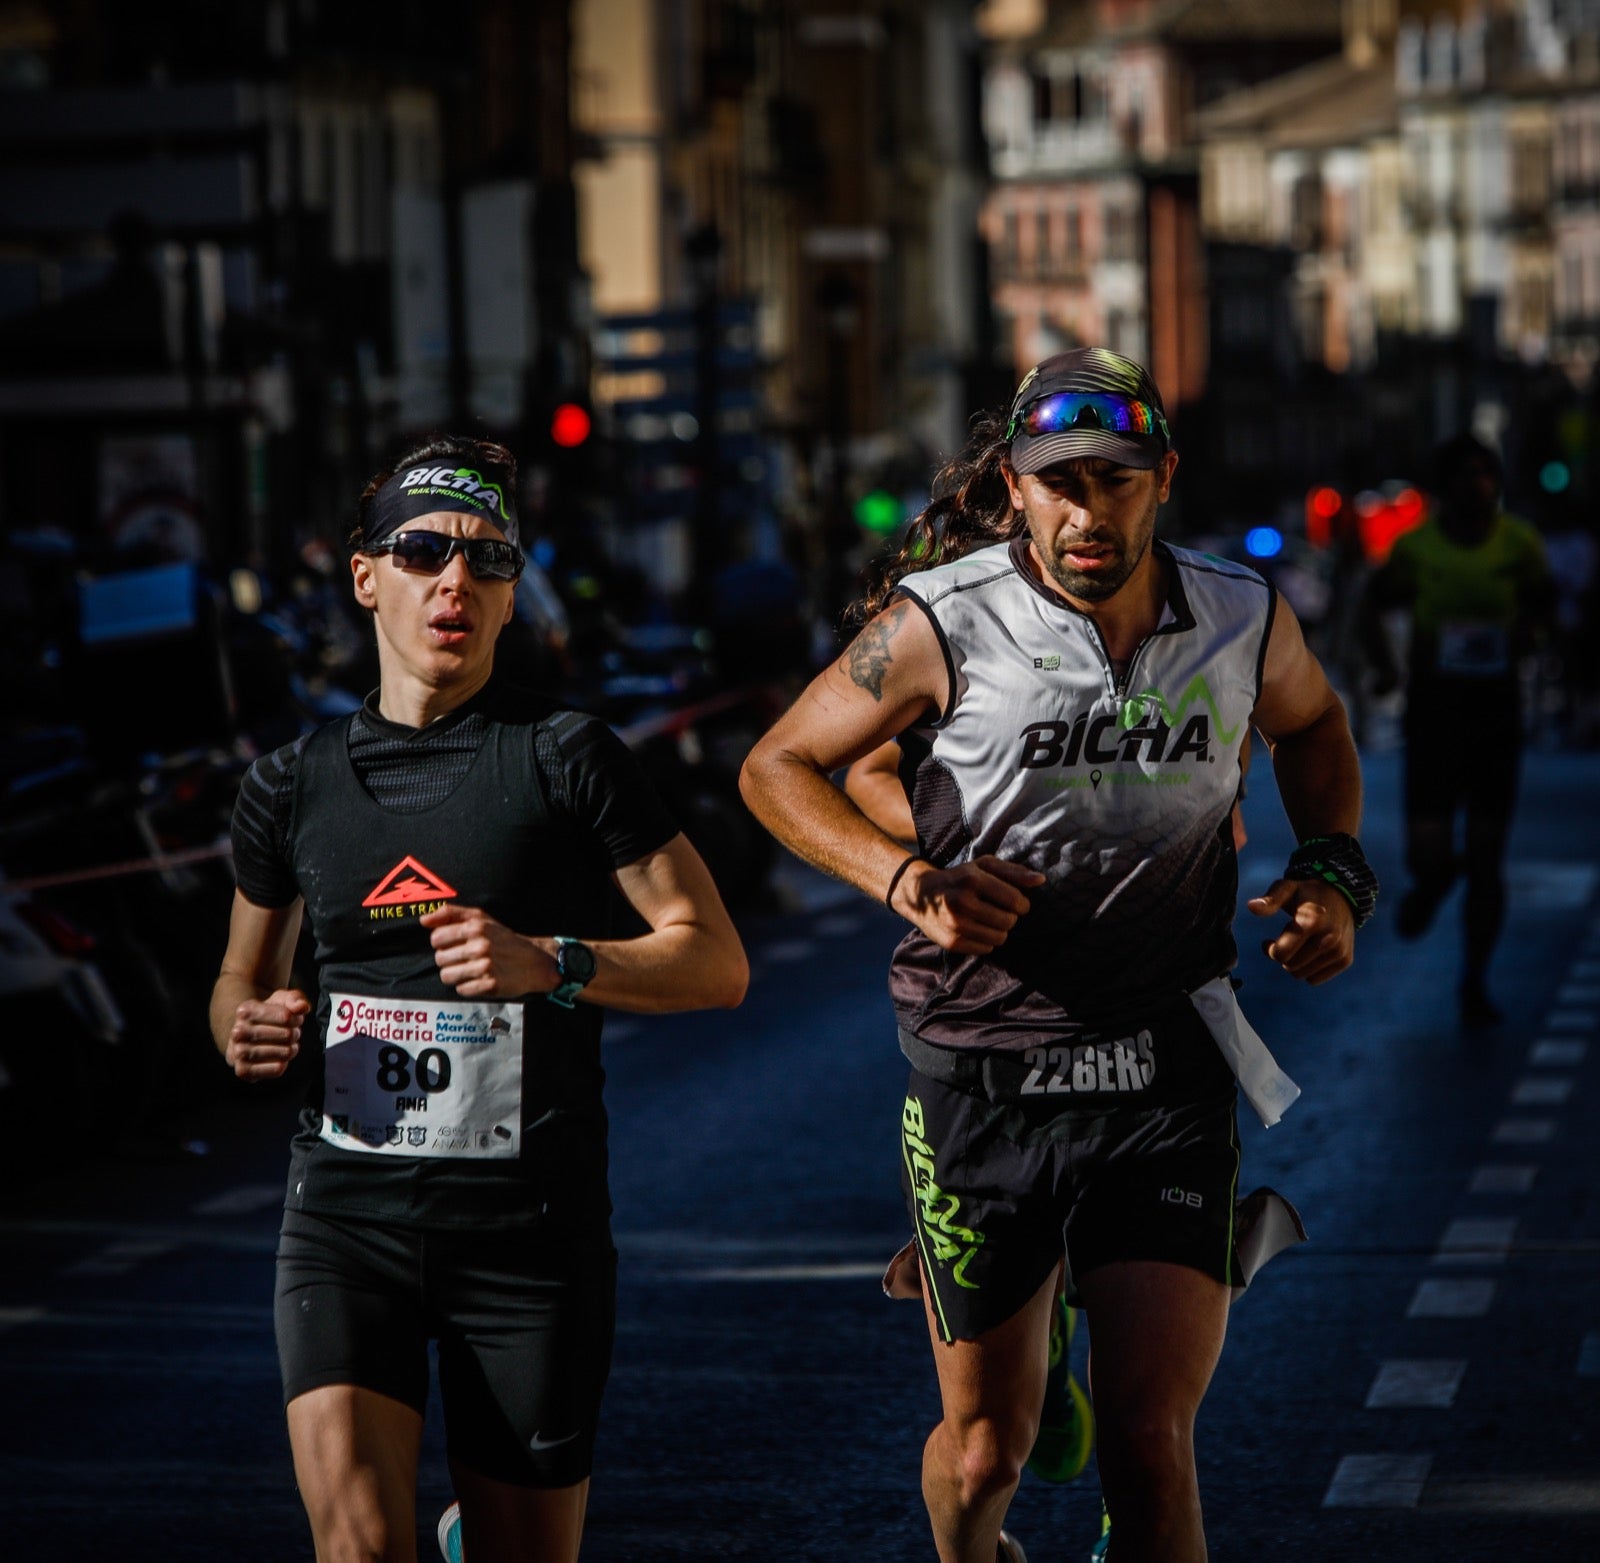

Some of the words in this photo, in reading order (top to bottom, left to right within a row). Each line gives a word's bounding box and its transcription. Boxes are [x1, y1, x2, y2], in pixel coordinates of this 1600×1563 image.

[399, 466, 499, 511] BICHA
[407, 486, 430, 496] TRAIL
[436, 488, 486, 510] MOUNTAIN
[1019, 711, 1210, 769] BICHA
[369, 905, 405, 920] NIKE
[336, 999, 354, 1034] 9
[356, 1002, 428, 1023] Carrera
[436, 1011, 463, 1021] Ave
[353, 1020, 433, 1042] Solidaria
[435, 1034, 496, 1044] Granada
[376, 1048, 451, 1094] 80
[1020, 1029, 1156, 1095] 226ERS
[395, 1097, 428, 1112] ANA
